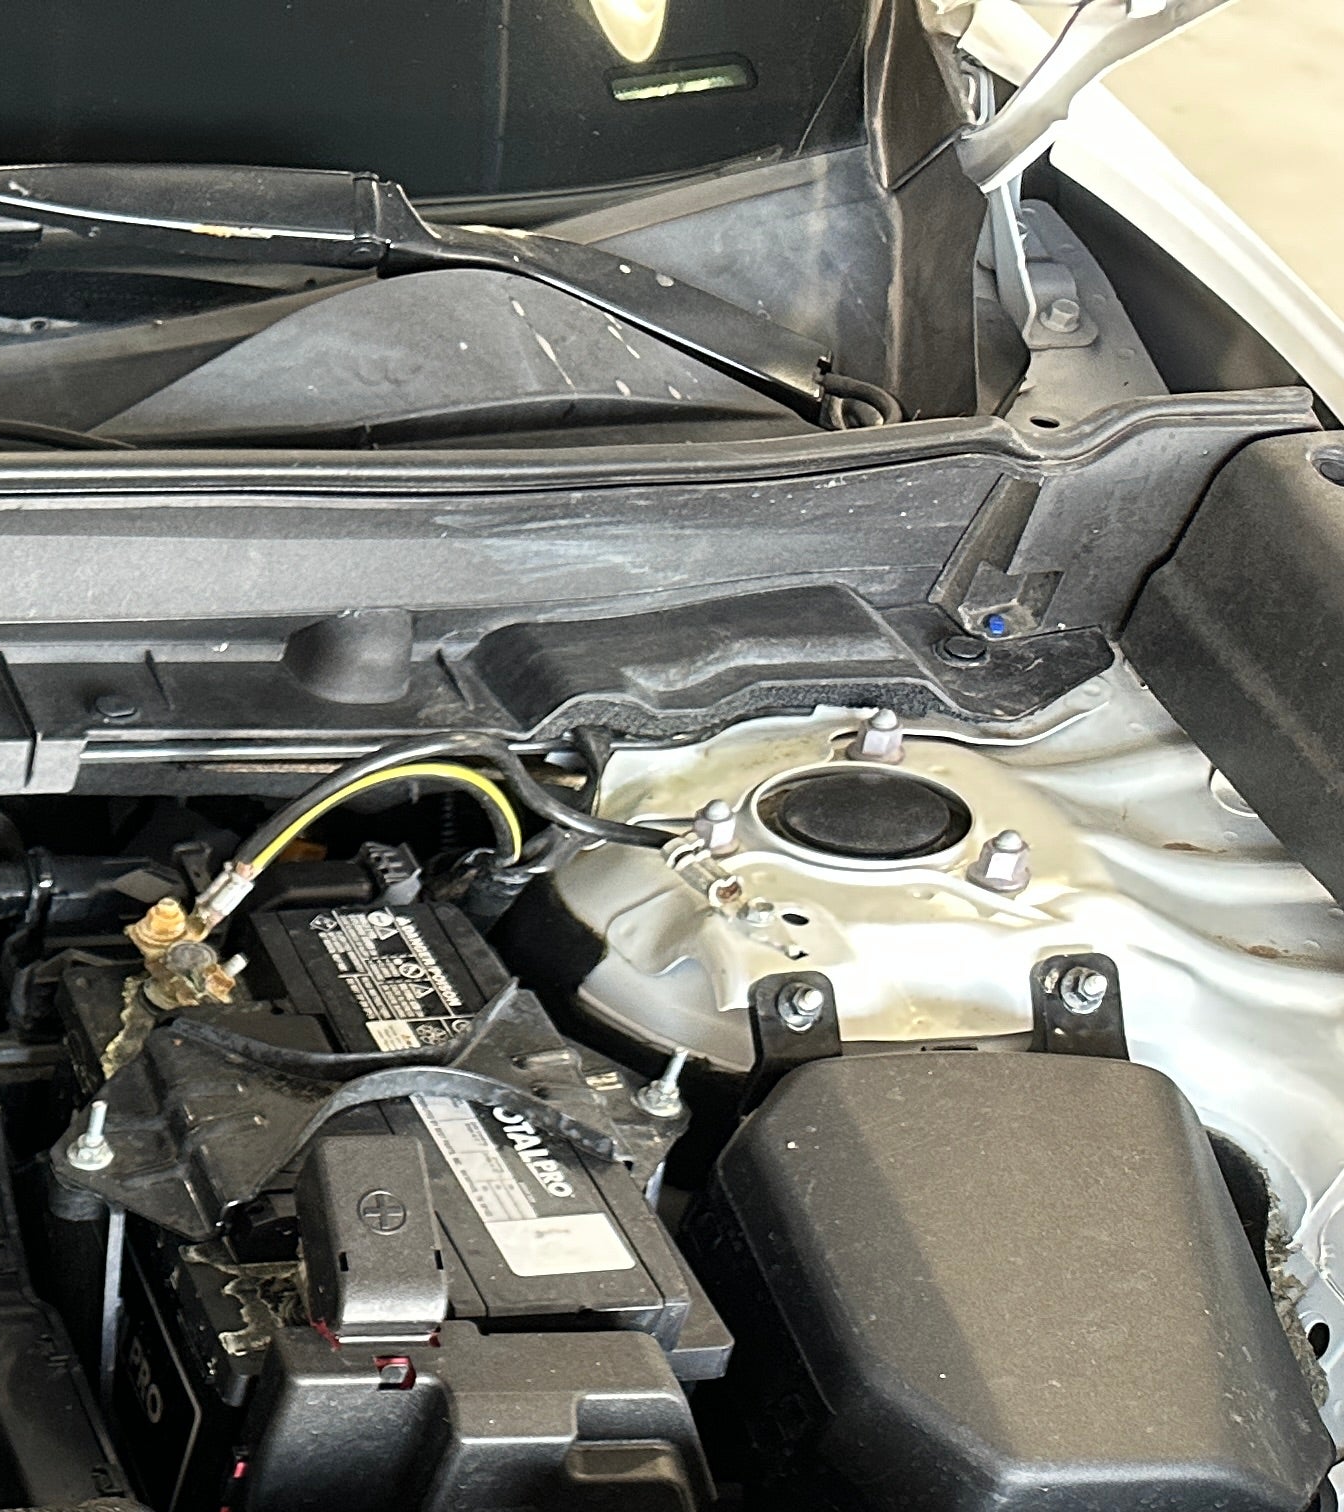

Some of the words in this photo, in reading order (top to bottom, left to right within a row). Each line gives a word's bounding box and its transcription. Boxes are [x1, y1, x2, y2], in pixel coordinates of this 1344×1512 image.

[401, 924, 437, 966] DANGER
[430, 965, 463, 1007] POISON
[491, 1106, 574, 1198] OTALPRO
